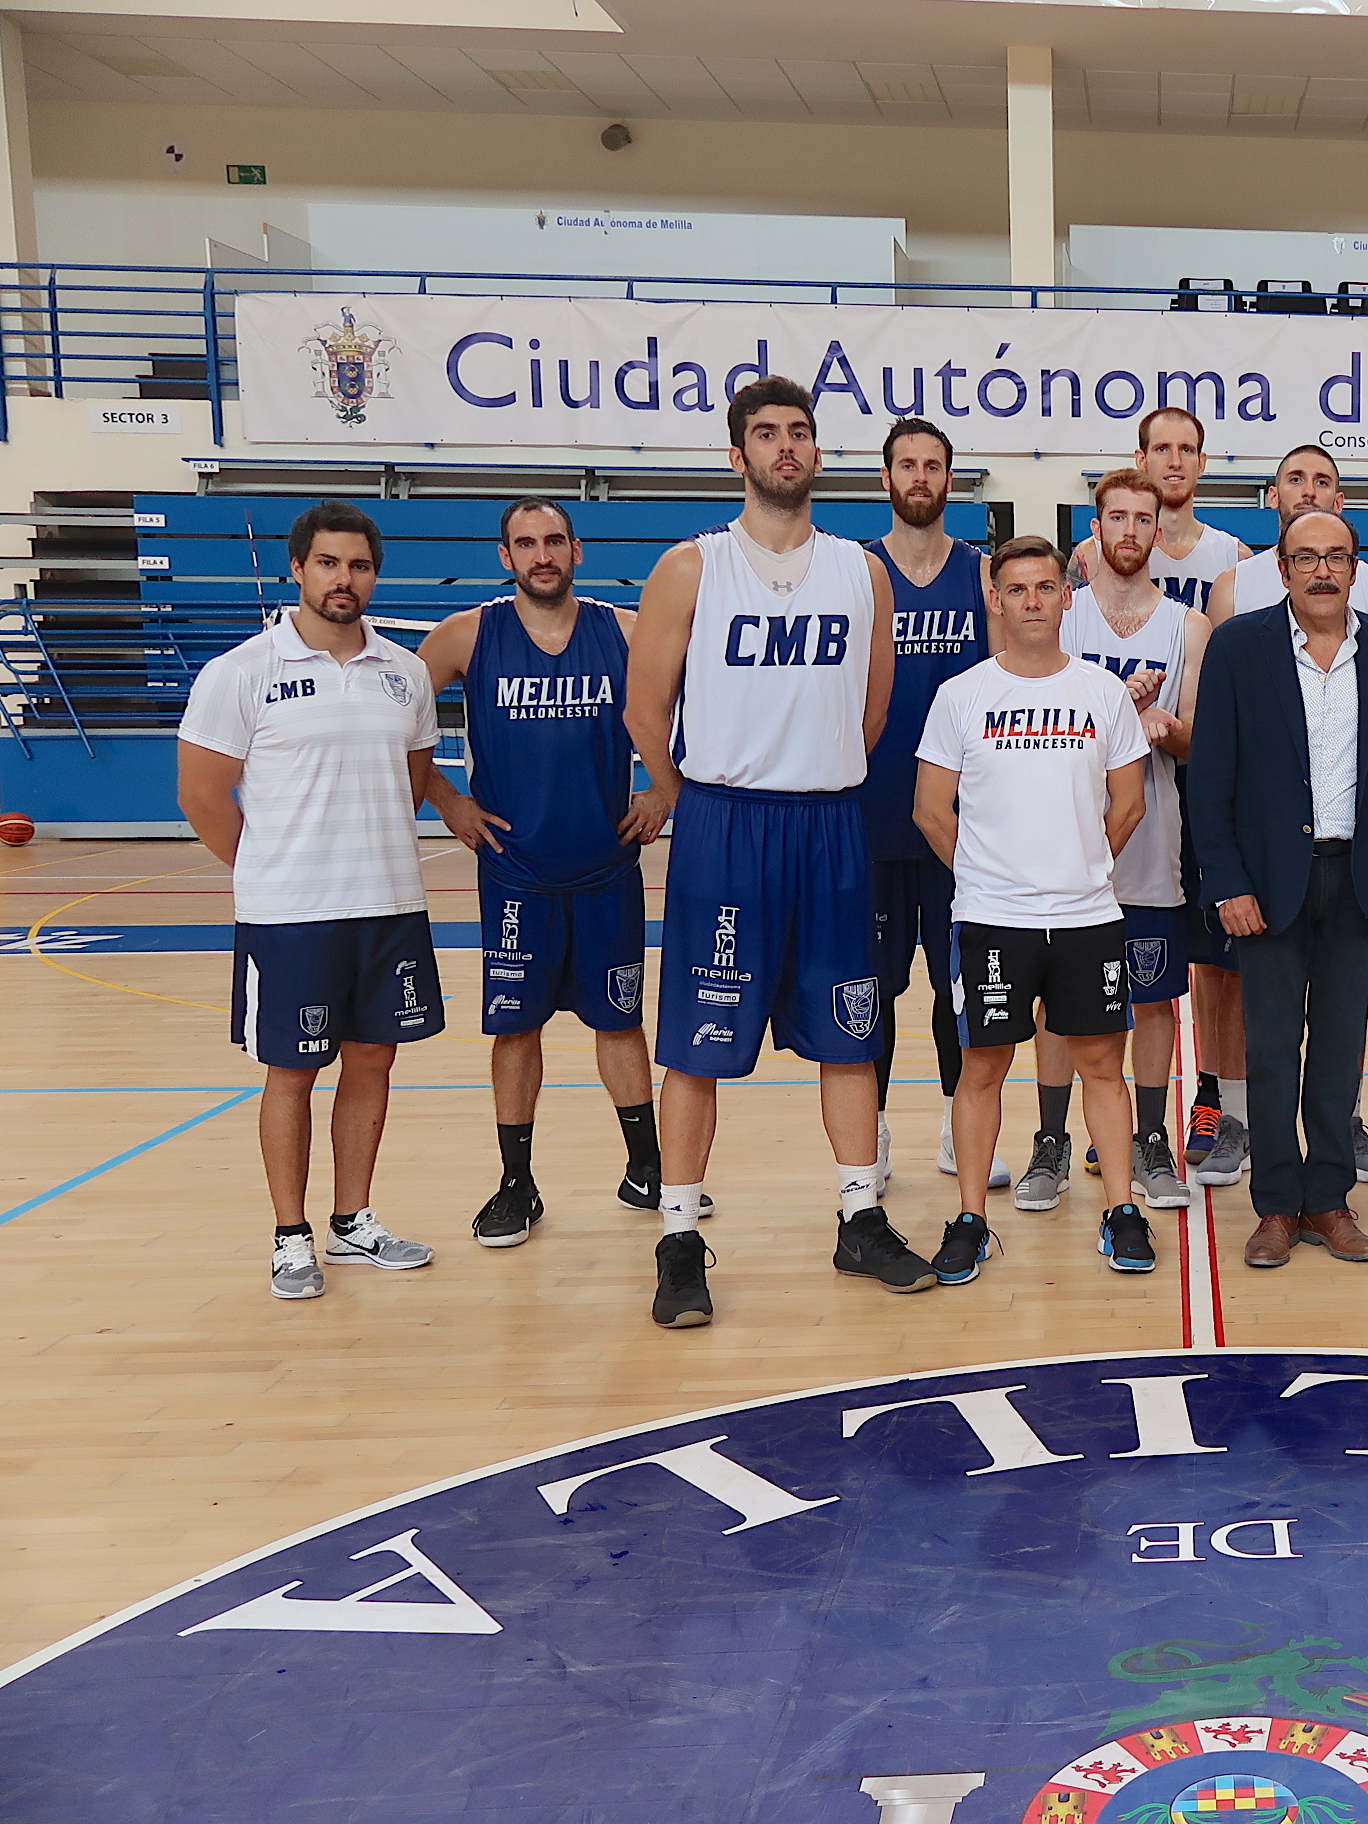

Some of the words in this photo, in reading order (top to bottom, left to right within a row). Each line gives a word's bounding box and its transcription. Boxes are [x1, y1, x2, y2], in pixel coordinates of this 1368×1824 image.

[556, 216, 590, 227] Ciudad
[593, 217, 642, 229] Auónoma
[645, 219, 658, 229] de
[660, 219, 693, 230] Melilla
[445, 331, 769, 412] Ciudad
[808, 340, 1278, 422] Autónoma
[102, 412, 155, 424] SECTOR
[161, 413, 169, 424] 3
[892, 610, 976, 642] ELILLA
[724, 614, 850, 667] CMB
[896, 642, 961, 655] LONCESTO
[496, 675, 614, 707] MELILLA
[509, 706, 599, 720] BALONCESTO
[982, 708, 1097, 739] MELILLA
[994, 738, 1084, 750] BALONCESTO
[484, 950, 533, 961] melilla
[491, 969, 523, 978] turismo
[691, 966, 752, 982] melilla
[977, 982, 1012, 991] melilla
[701, 990, 737, 1002] turismo
[298, 1039, 330, 1053] CMB
[1130, 1517, 1305, 1564] DE
